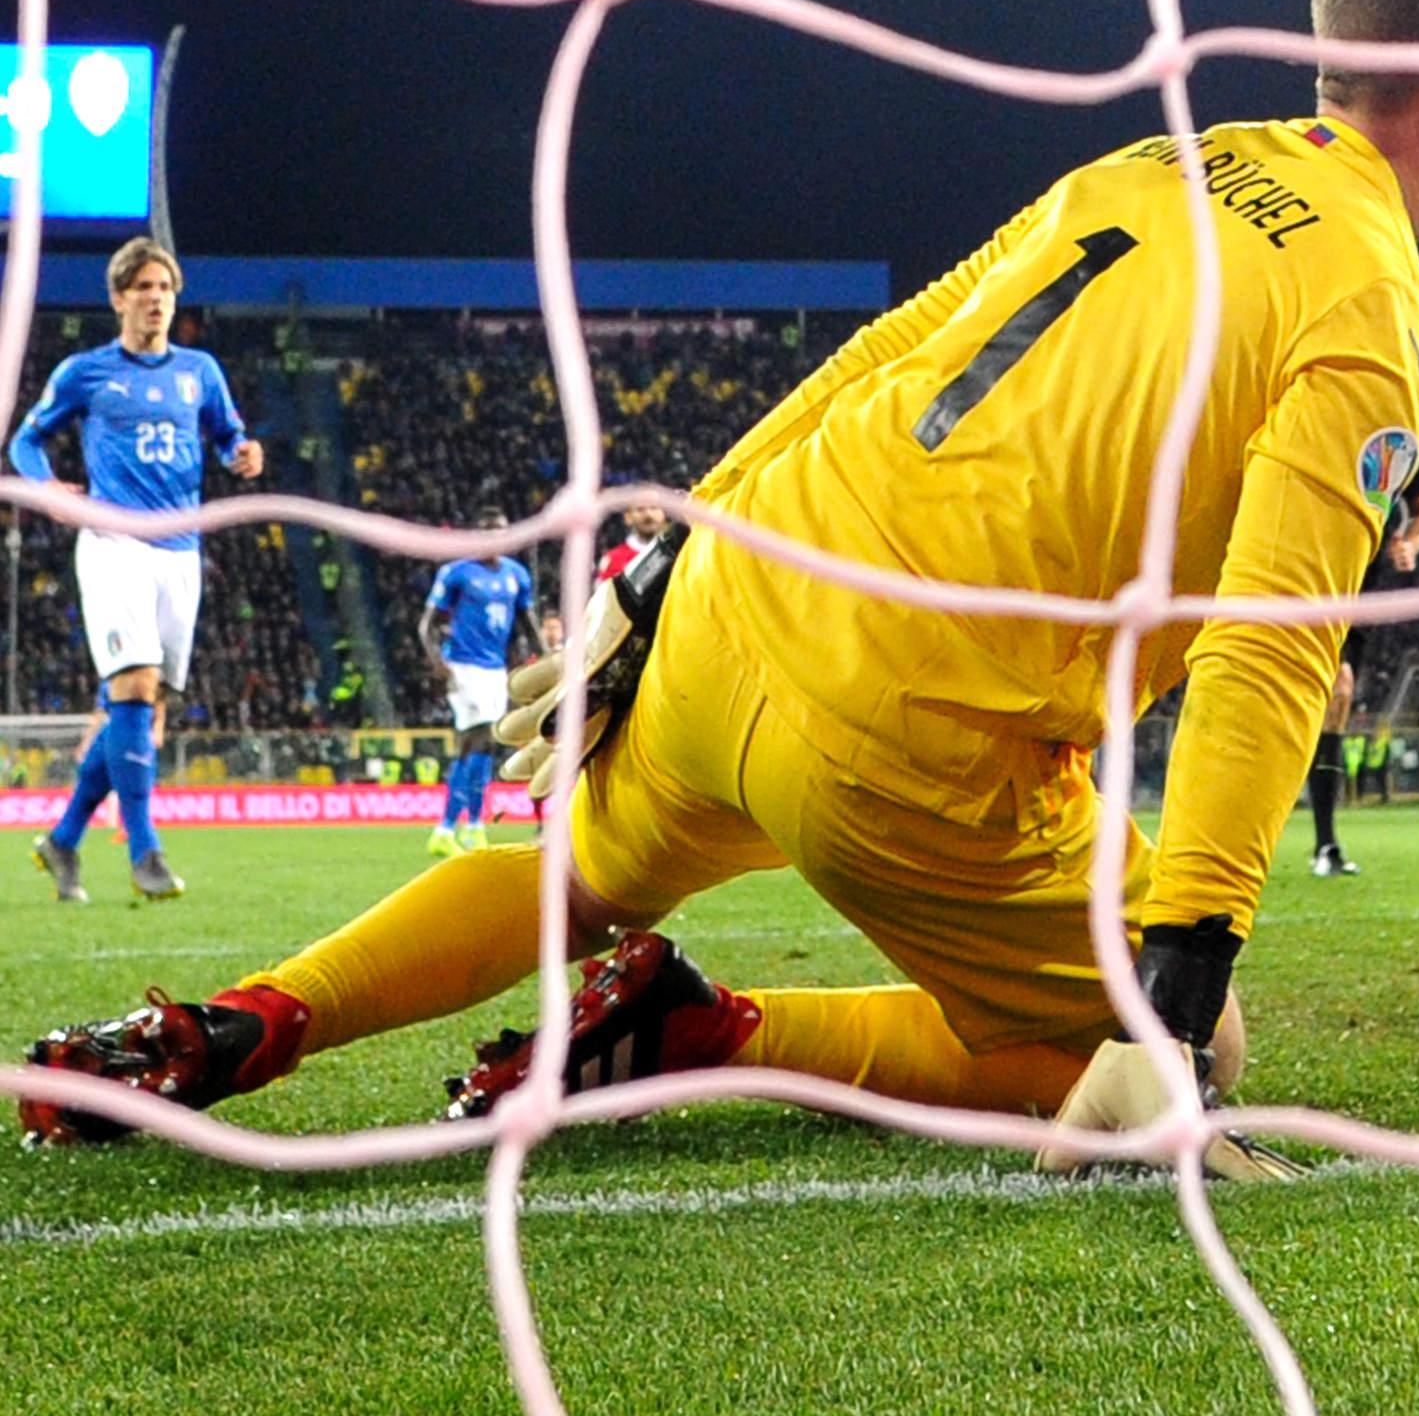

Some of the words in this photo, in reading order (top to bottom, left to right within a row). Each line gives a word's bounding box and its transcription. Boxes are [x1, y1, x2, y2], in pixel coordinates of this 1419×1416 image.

[910, 225, 1141, 453] 1
[135, 421, 176, 464] 23
[245, 793, 320, 819] BELLO
[323, 792, 351, 818] DI
